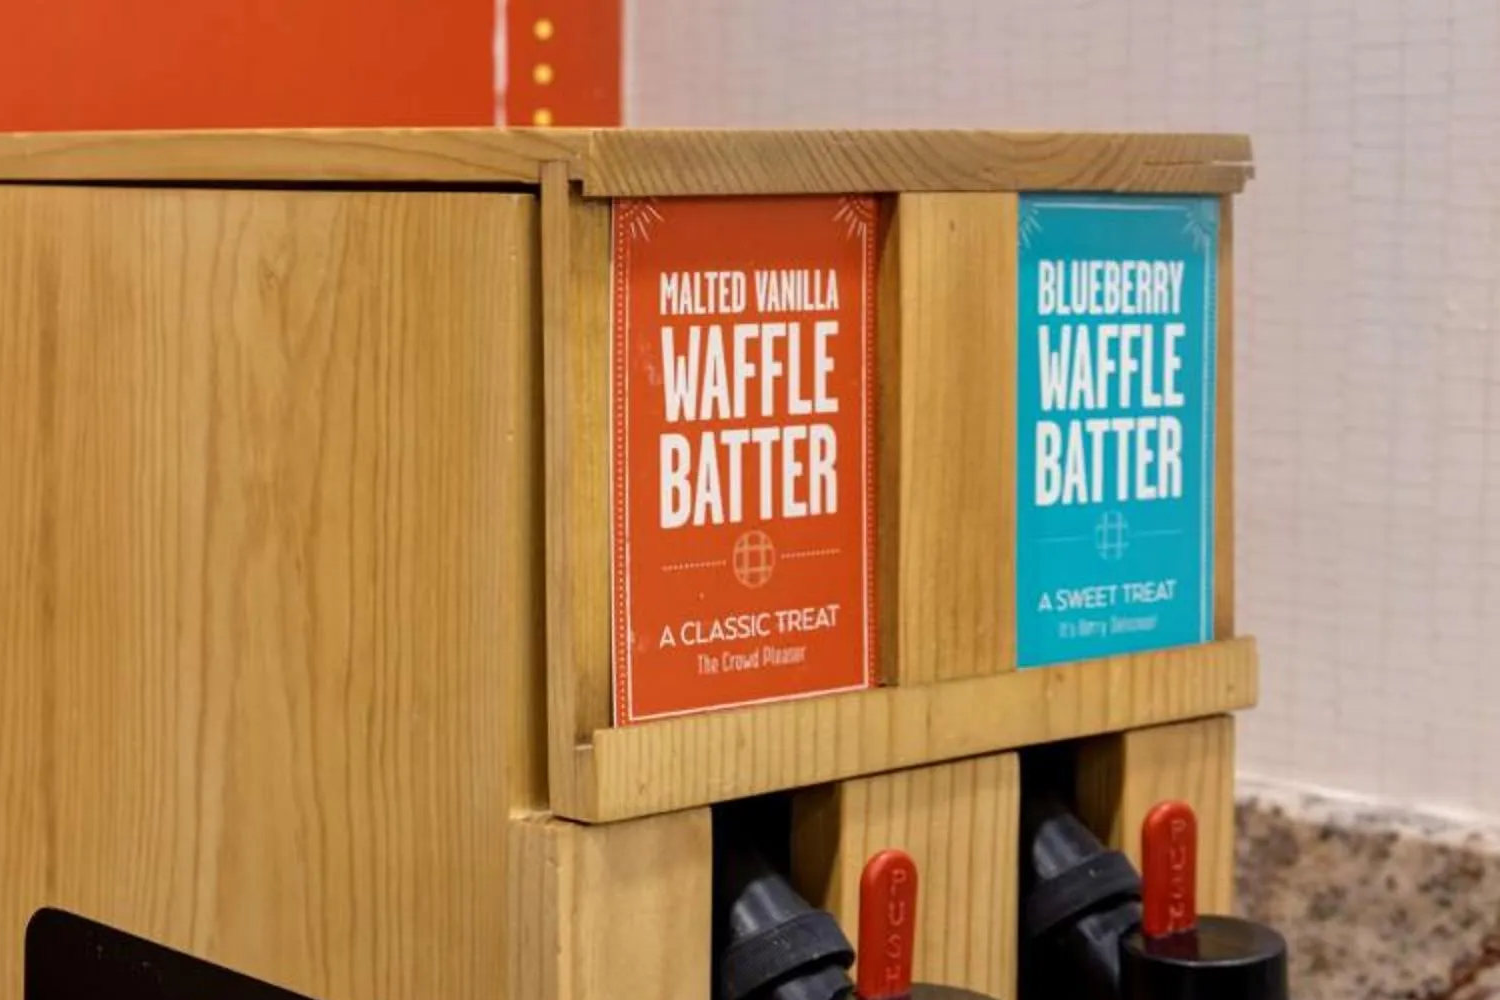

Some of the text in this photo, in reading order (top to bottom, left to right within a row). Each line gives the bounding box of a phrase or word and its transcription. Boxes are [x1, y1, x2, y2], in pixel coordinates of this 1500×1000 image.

[659, 268, 840, 316] MALTED VANILLA
[1038, 259, 1185, 315] BLUEBERRY
[661, 321, 840, 423] WAFFLE
[1038, 322, 1186, 411] WAFFLE
[659, 423, 839, 530] BATTER
[1035, 415, 1183, 507] BATTER
[1037, 578, 1177, 613] A SWEET TREAT
[659, 604, 840, 648] A CLASSIC TREAT
[697, 645, 807, 675] The Crowd Pleaser
